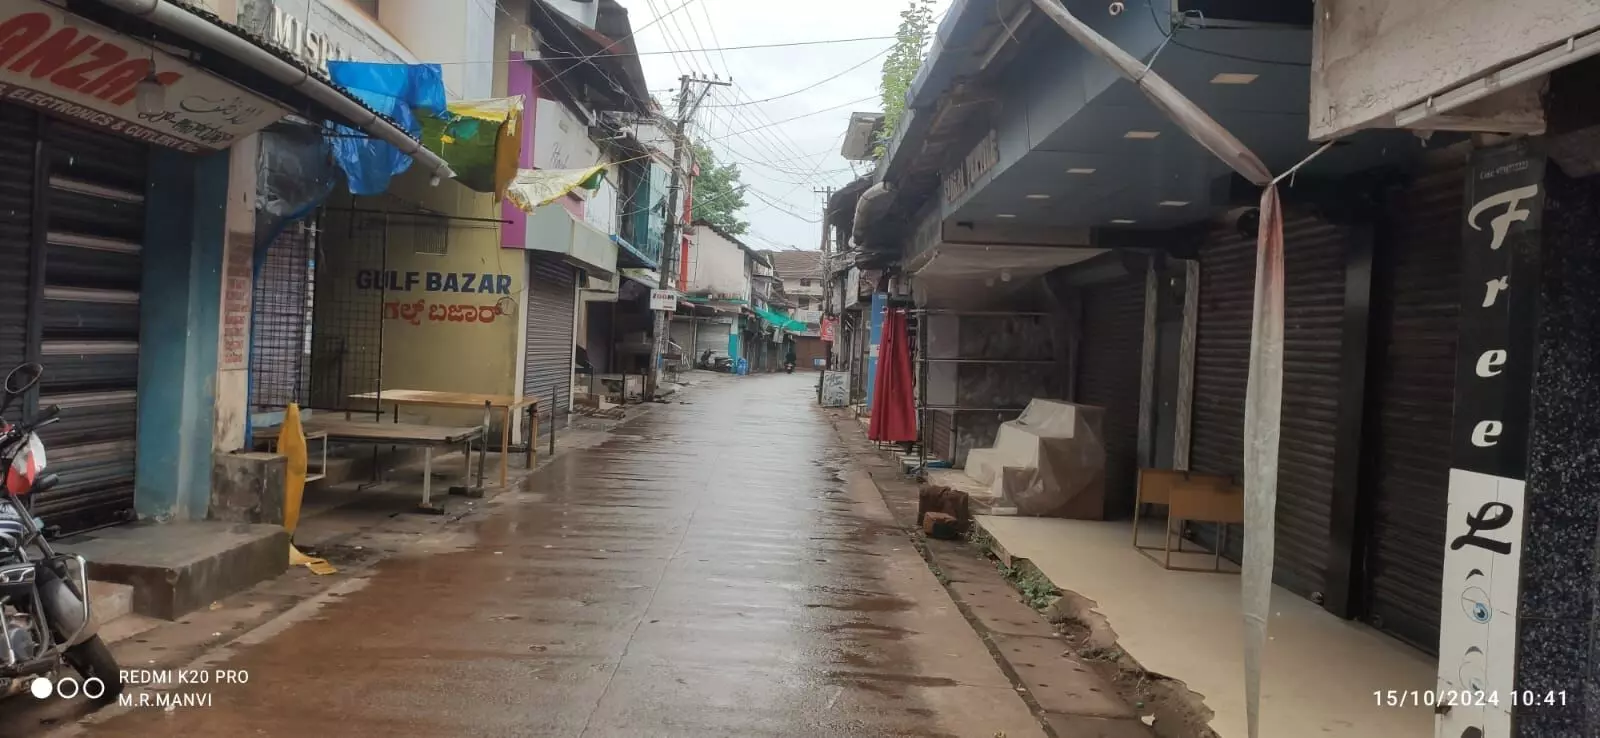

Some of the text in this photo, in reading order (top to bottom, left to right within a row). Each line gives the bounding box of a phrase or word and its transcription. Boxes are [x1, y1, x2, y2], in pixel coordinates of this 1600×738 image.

[8, 86, 114, 127] ELECTRONICS
[111, 119, 126, 131] &
[124, 125, 180, 147] CUTLERY
[356, 269, 512, 295] GULF BAZAR
